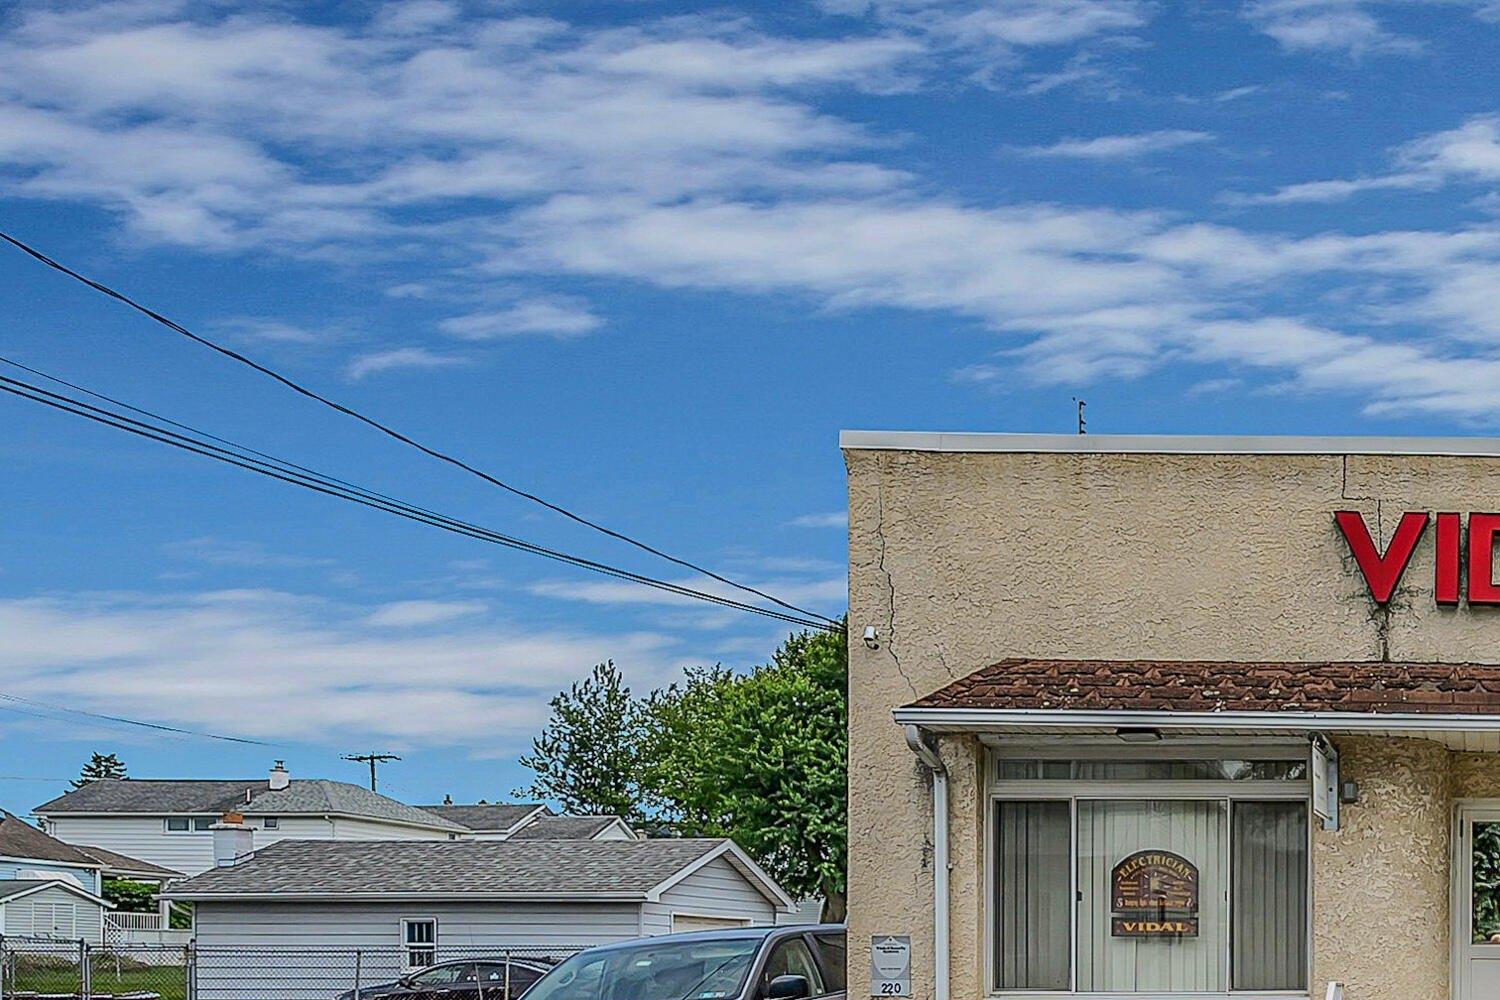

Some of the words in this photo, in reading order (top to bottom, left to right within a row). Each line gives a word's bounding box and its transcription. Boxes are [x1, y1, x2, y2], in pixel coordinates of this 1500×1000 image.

[1119, 855, 1192, 878] ELECTRICIAN
[1123, 922, 1188, 932] VIDAL
[881, 983, 901, 993] 220
